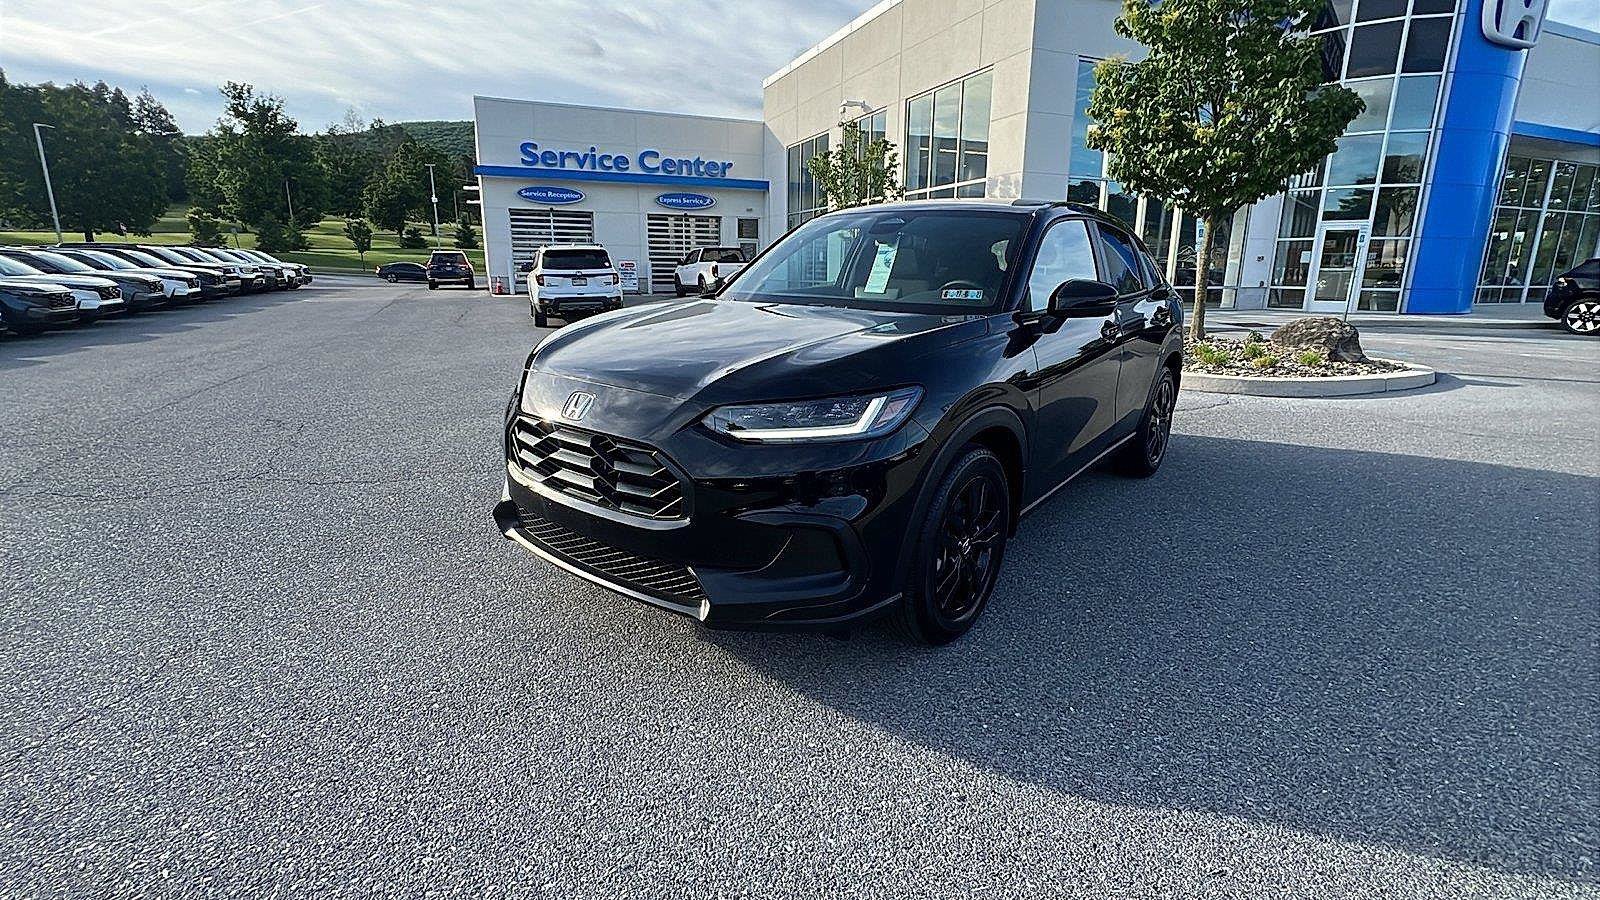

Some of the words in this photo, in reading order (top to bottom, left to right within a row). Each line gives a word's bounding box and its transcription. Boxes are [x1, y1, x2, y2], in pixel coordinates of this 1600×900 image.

[519, 141, 630, 172] Service
[638, 150, 733, 178] Center
[521, 189, 546, 197] Service
[547, 191, 581, 200] Reception
[659, 196, 682, 205] Express
[682, 197, 703, 205] Service
